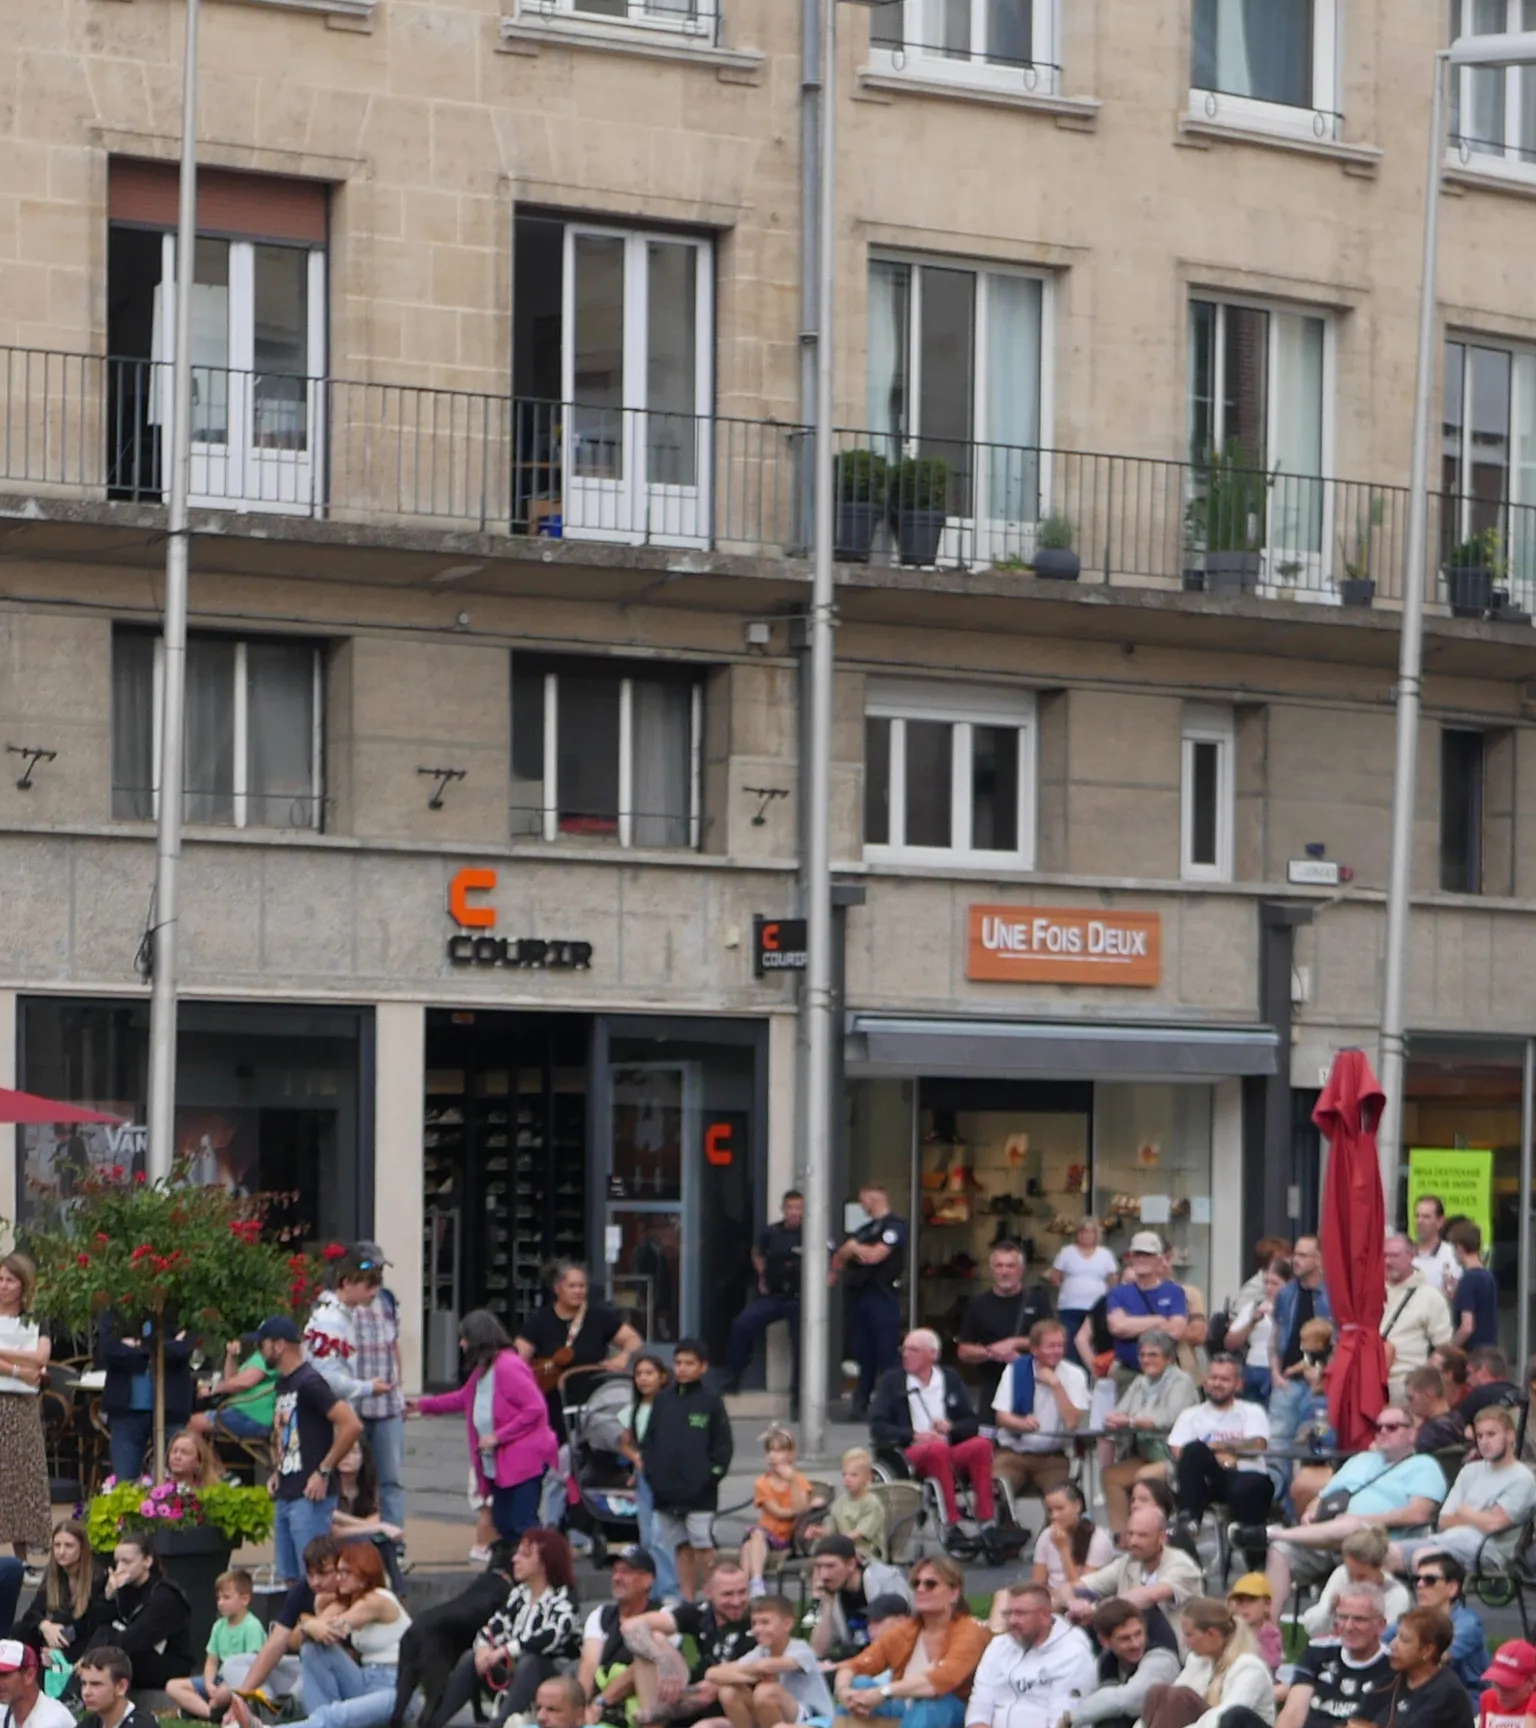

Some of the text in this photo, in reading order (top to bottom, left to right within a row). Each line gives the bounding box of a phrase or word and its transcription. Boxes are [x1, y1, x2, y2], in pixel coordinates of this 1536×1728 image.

[447, 935, 594, 971] COURIR
[981, 916, 1147, 957] UNE FOIS DEUX
[104, 1123, 148, 1153] VAN
